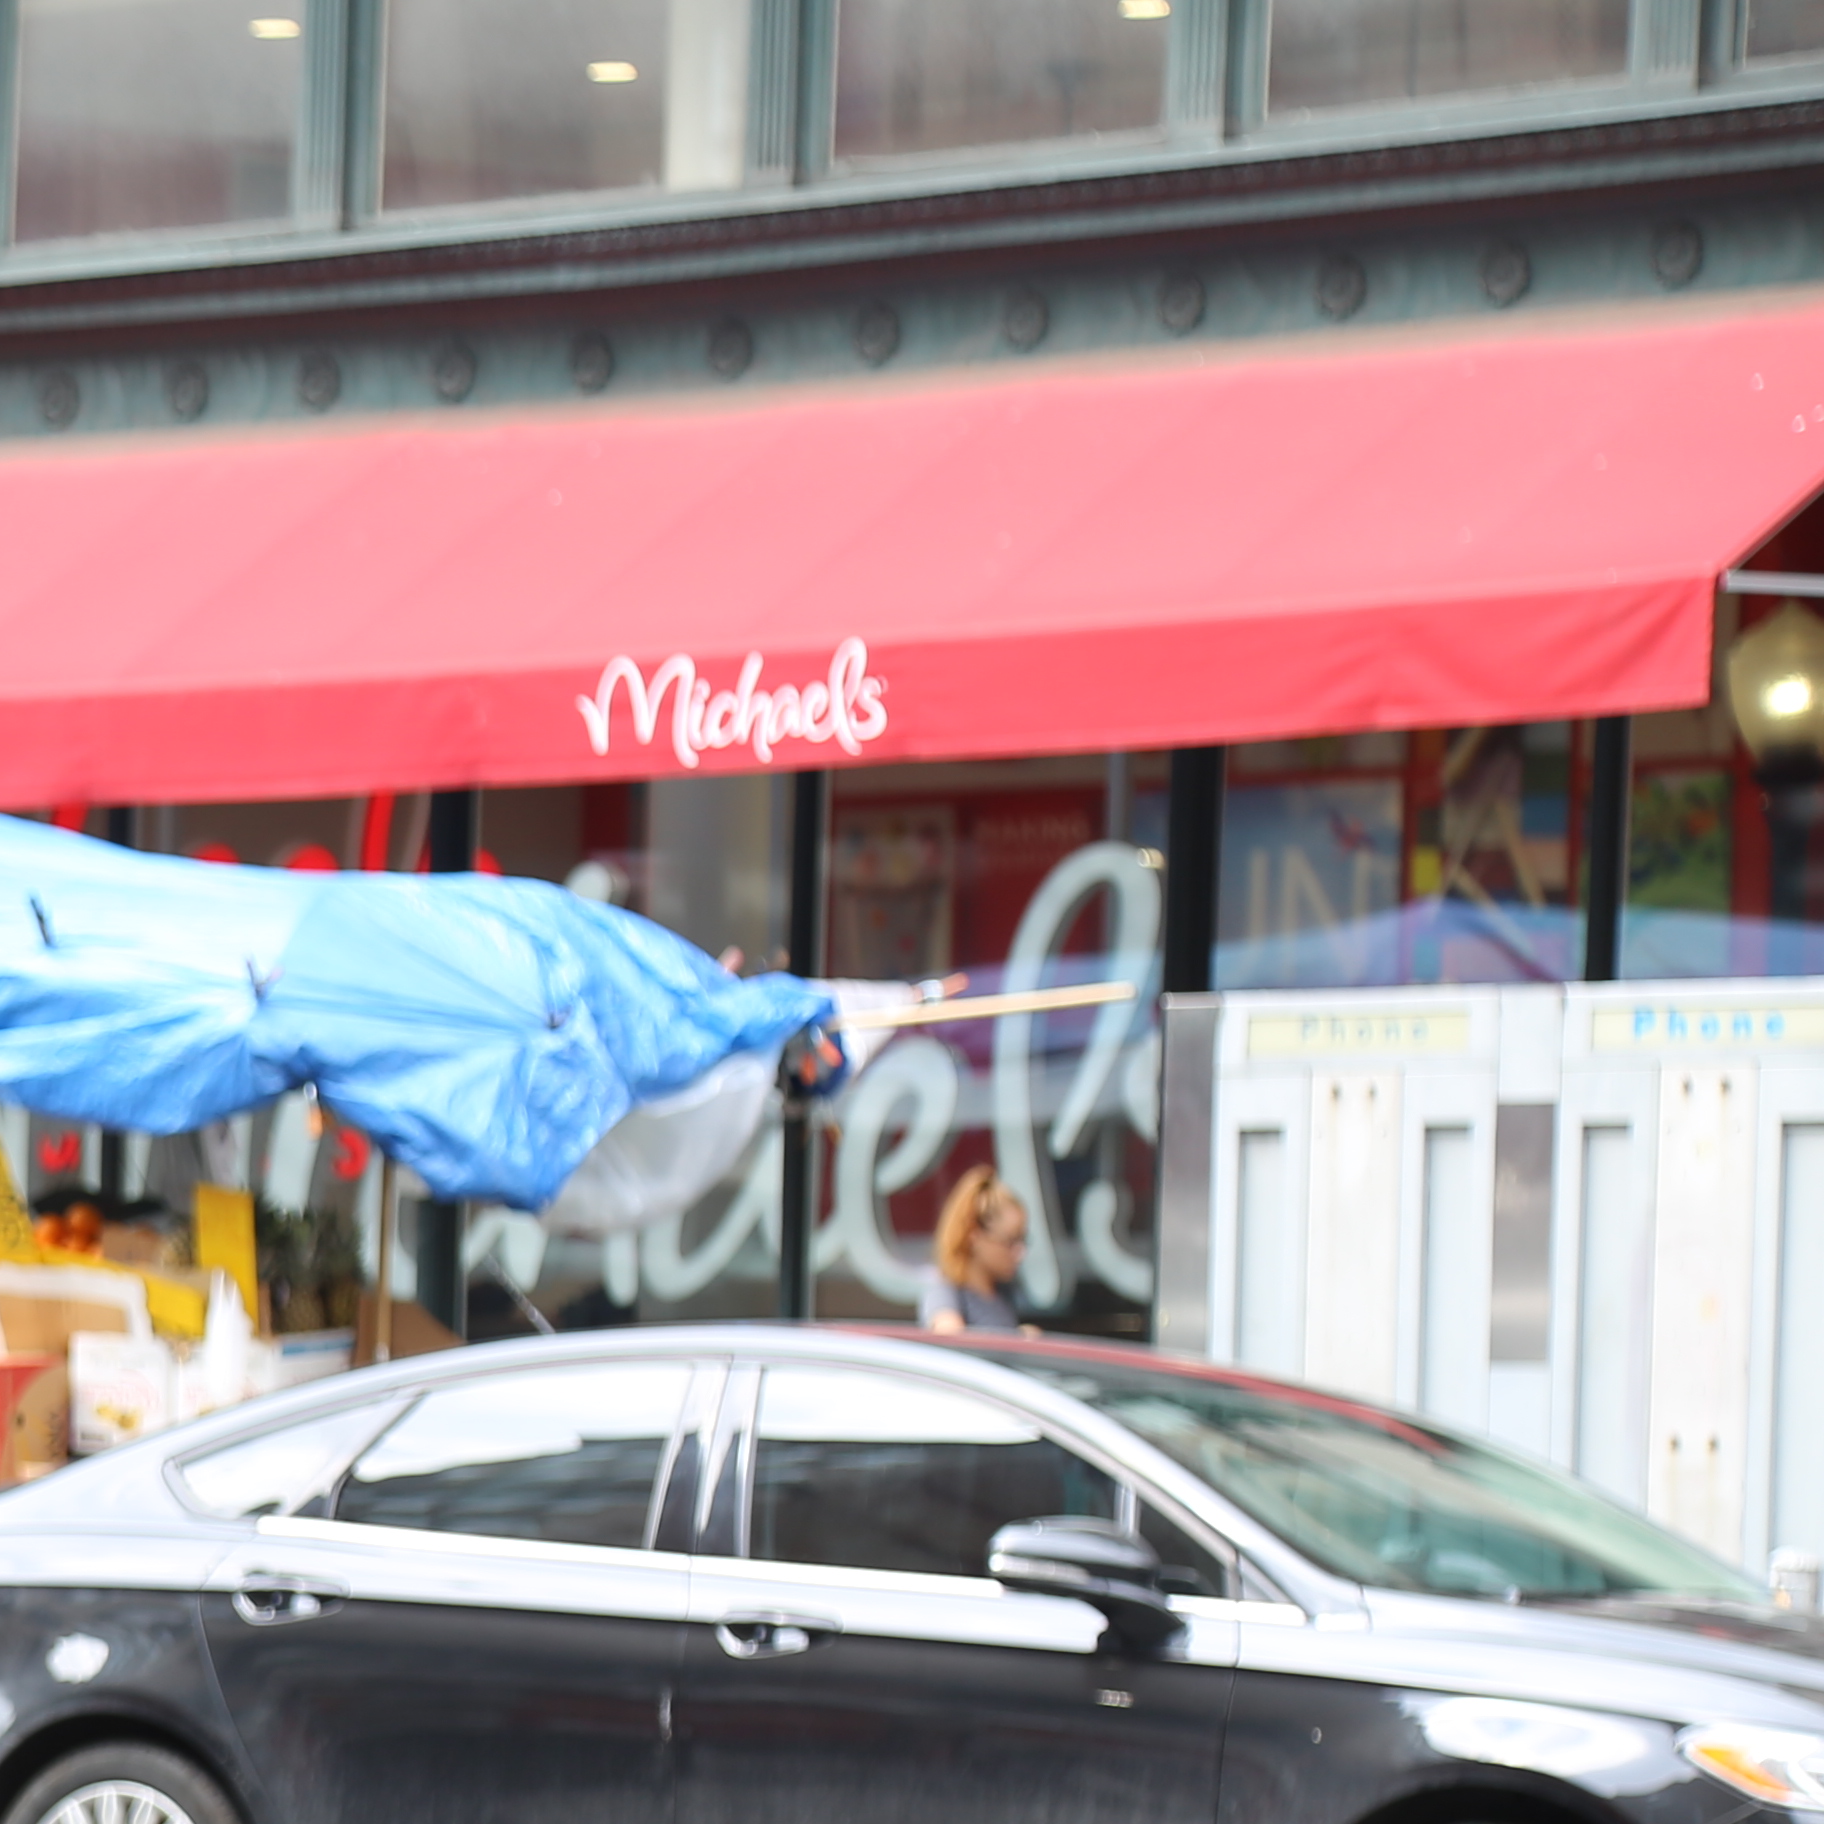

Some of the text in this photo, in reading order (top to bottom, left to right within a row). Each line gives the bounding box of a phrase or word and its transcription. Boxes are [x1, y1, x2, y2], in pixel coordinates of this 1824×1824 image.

[574, 635, 888, 769] Michaels
[1299, 1013, 1430, 1044] Phone
[1632, 1006, 1786, 1041] Phone
